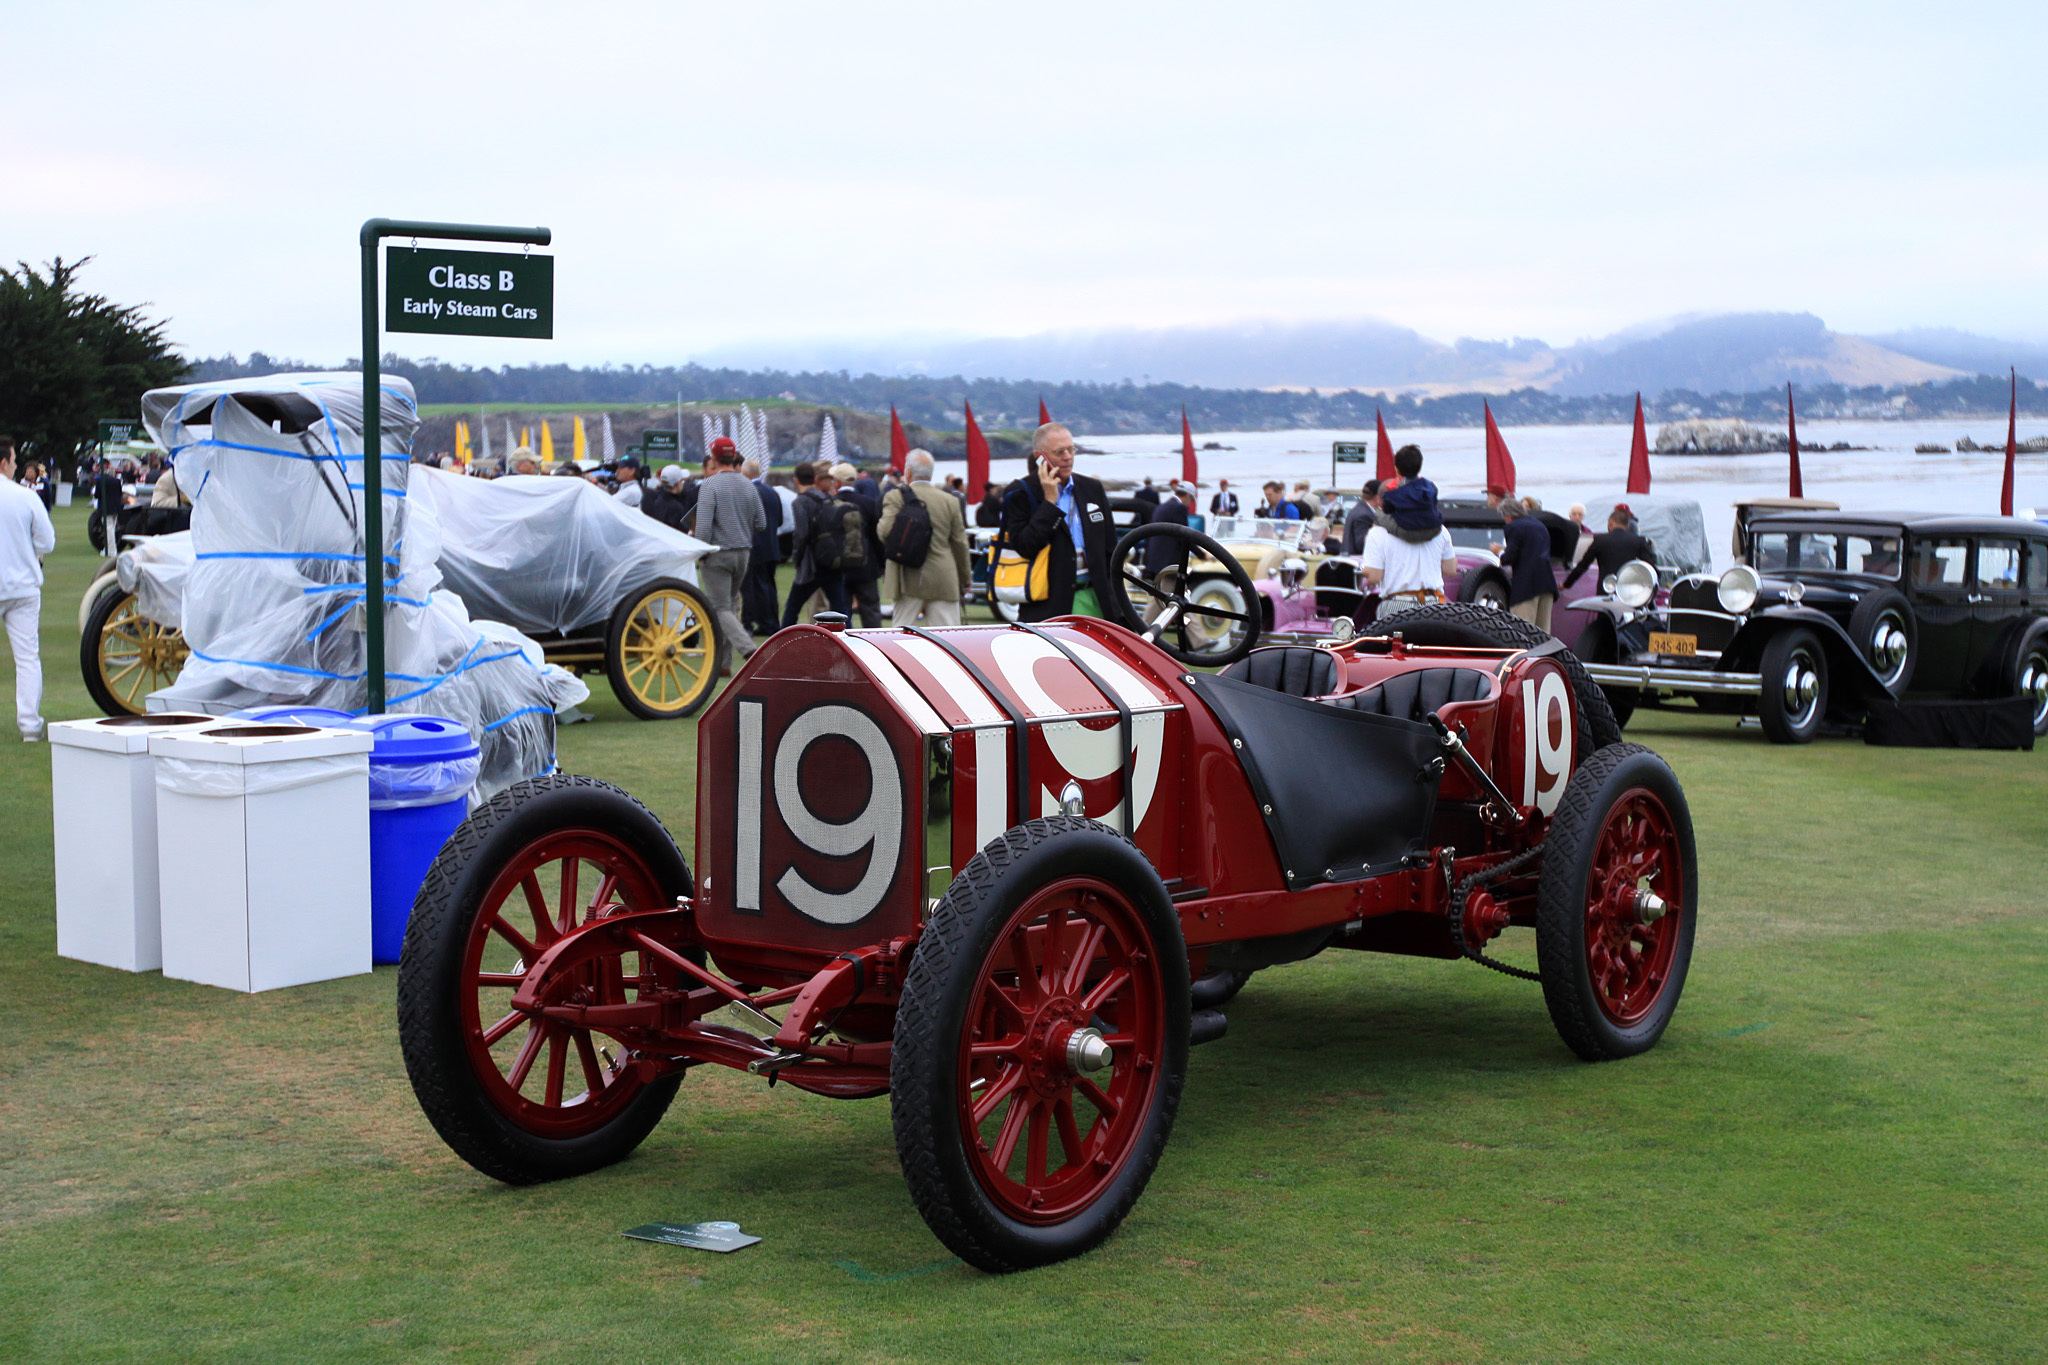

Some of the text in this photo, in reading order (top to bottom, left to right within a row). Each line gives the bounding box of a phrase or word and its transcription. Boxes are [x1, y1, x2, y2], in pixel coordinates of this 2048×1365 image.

[403, 297, 538, 320] Early Steam Cars
[428, 265, 514, 292] Class B
[1653, 640, 1695, 654] 345 403
[892, 633, 1165, 854] 19
[1522, 672, 1572, 818] 19
[735, 700, 904, 925] 19
